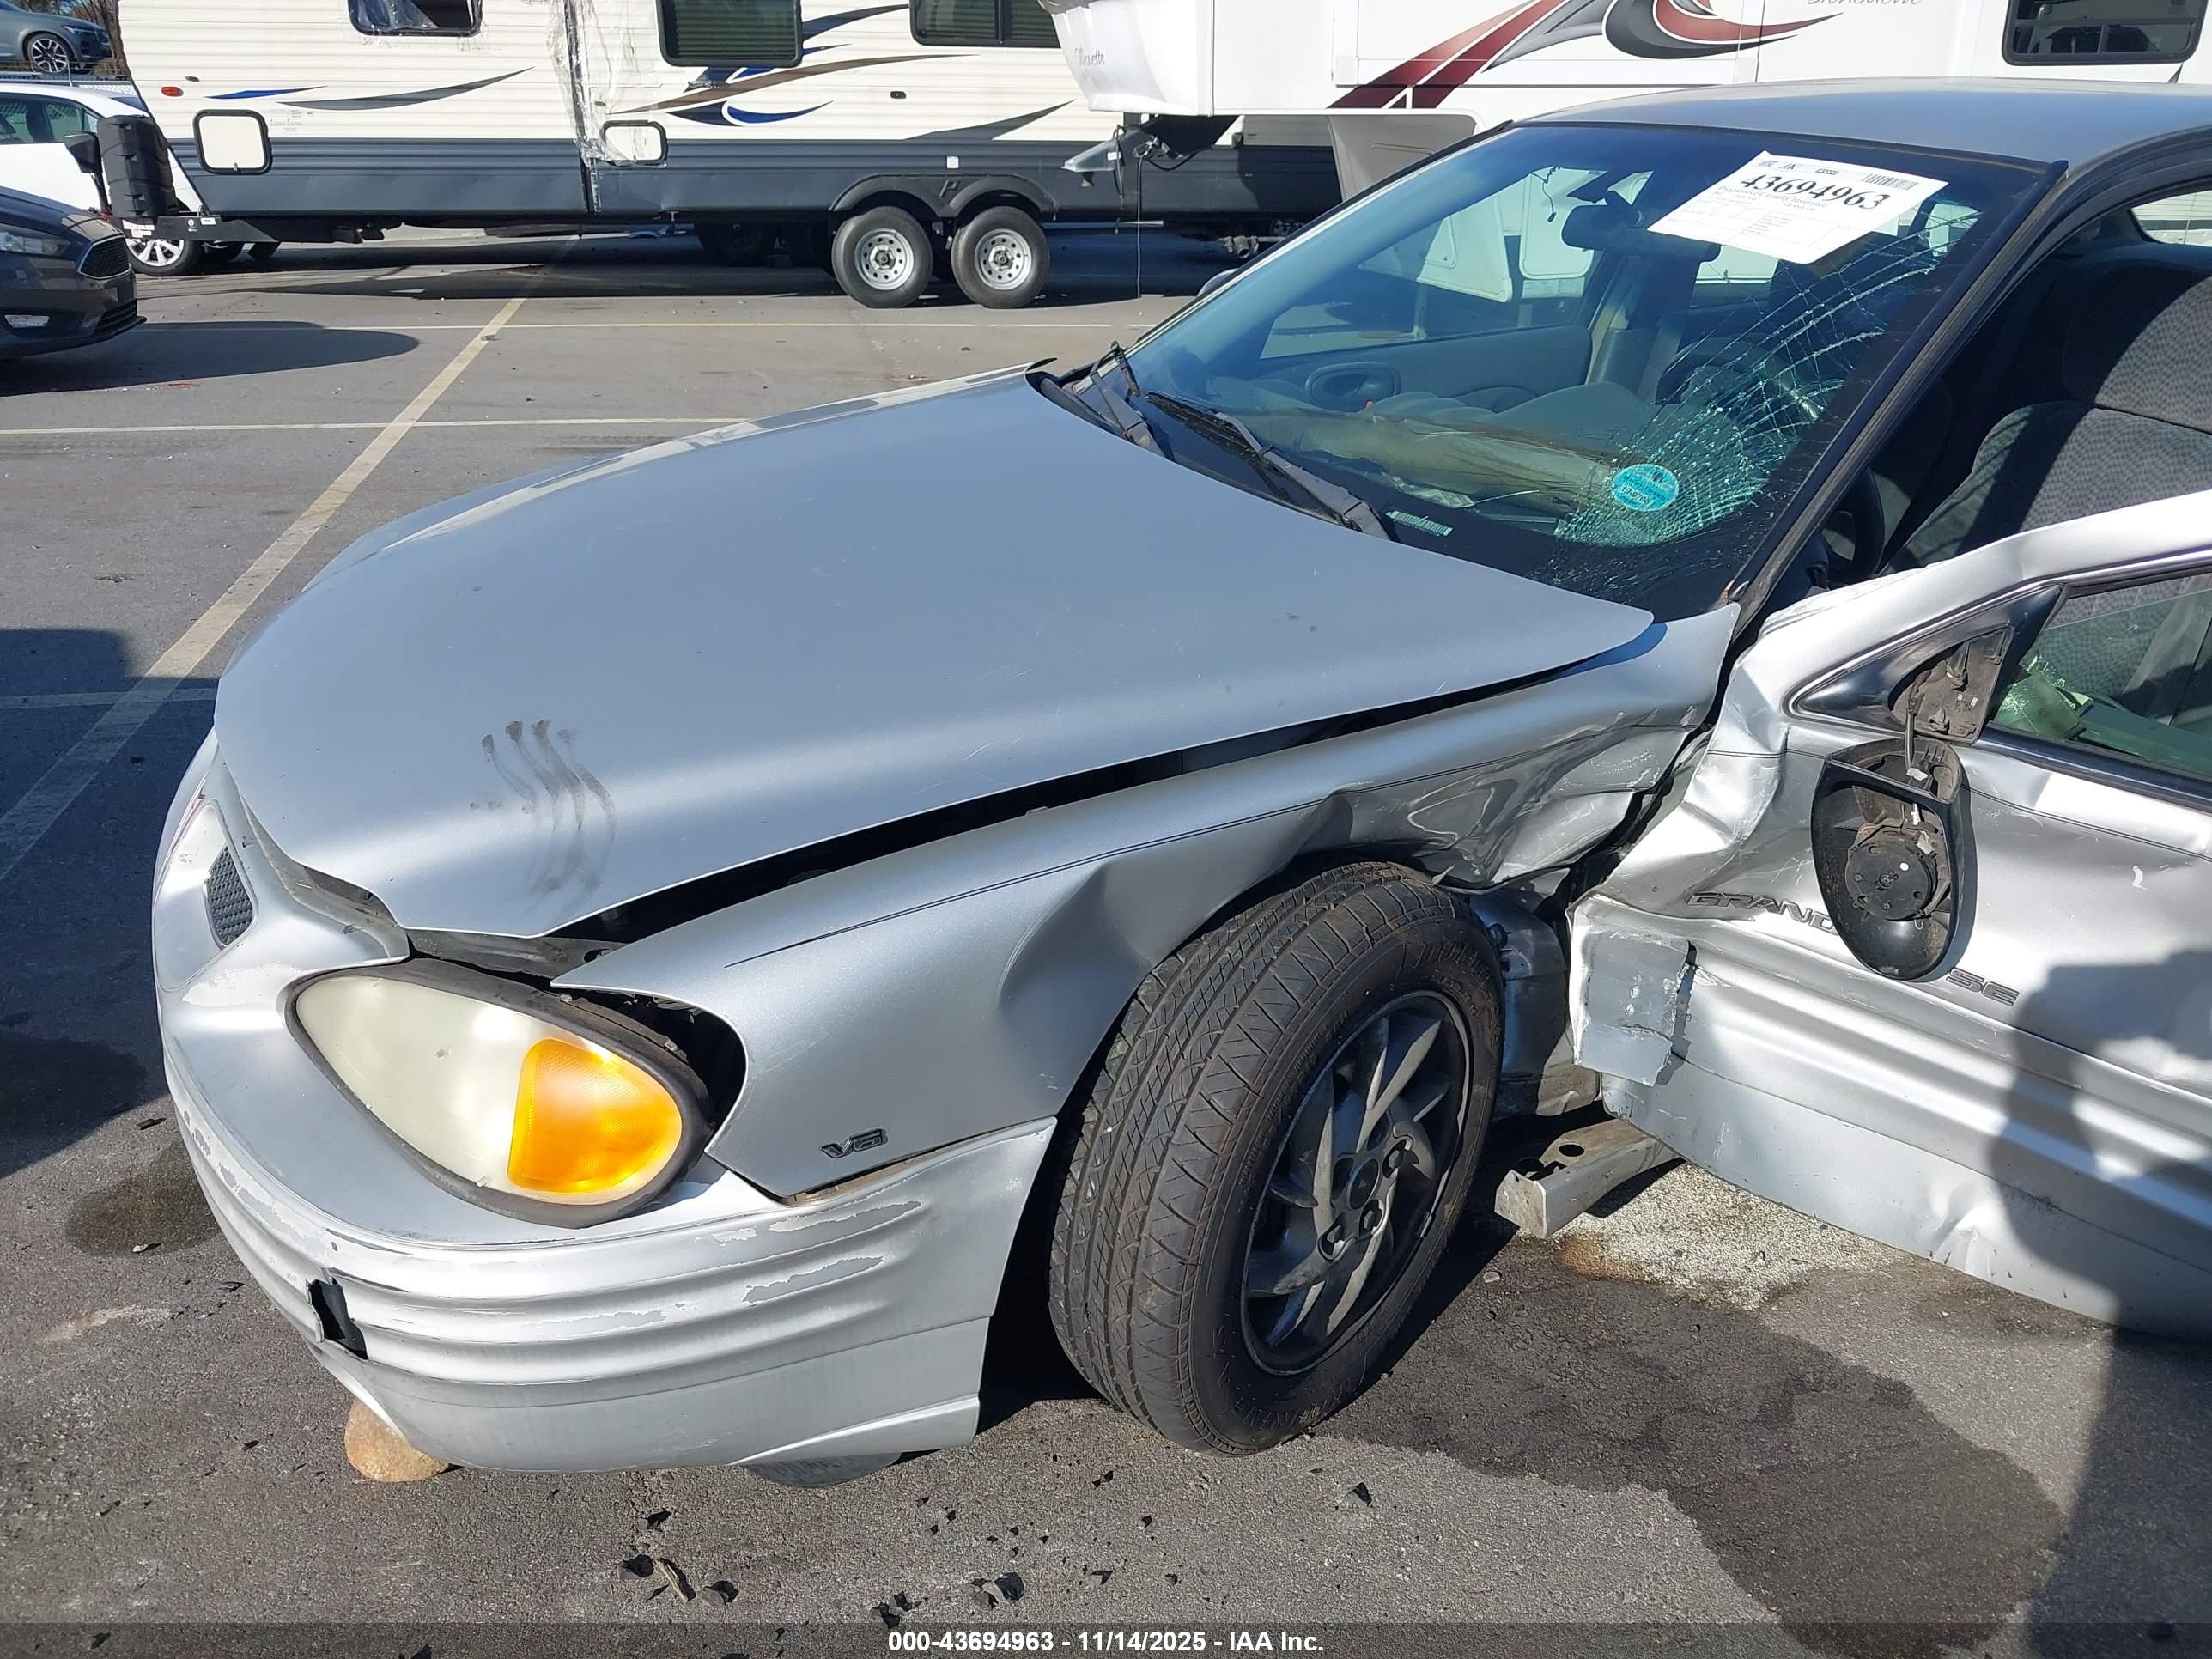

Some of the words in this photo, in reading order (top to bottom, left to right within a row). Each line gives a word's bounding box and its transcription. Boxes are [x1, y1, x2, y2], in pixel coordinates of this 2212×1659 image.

[1741, 174, 1891, 210] 43694963
[1686, 892, 1839, 936] GRAND
[1945, 967, 2021, 1007] SE
